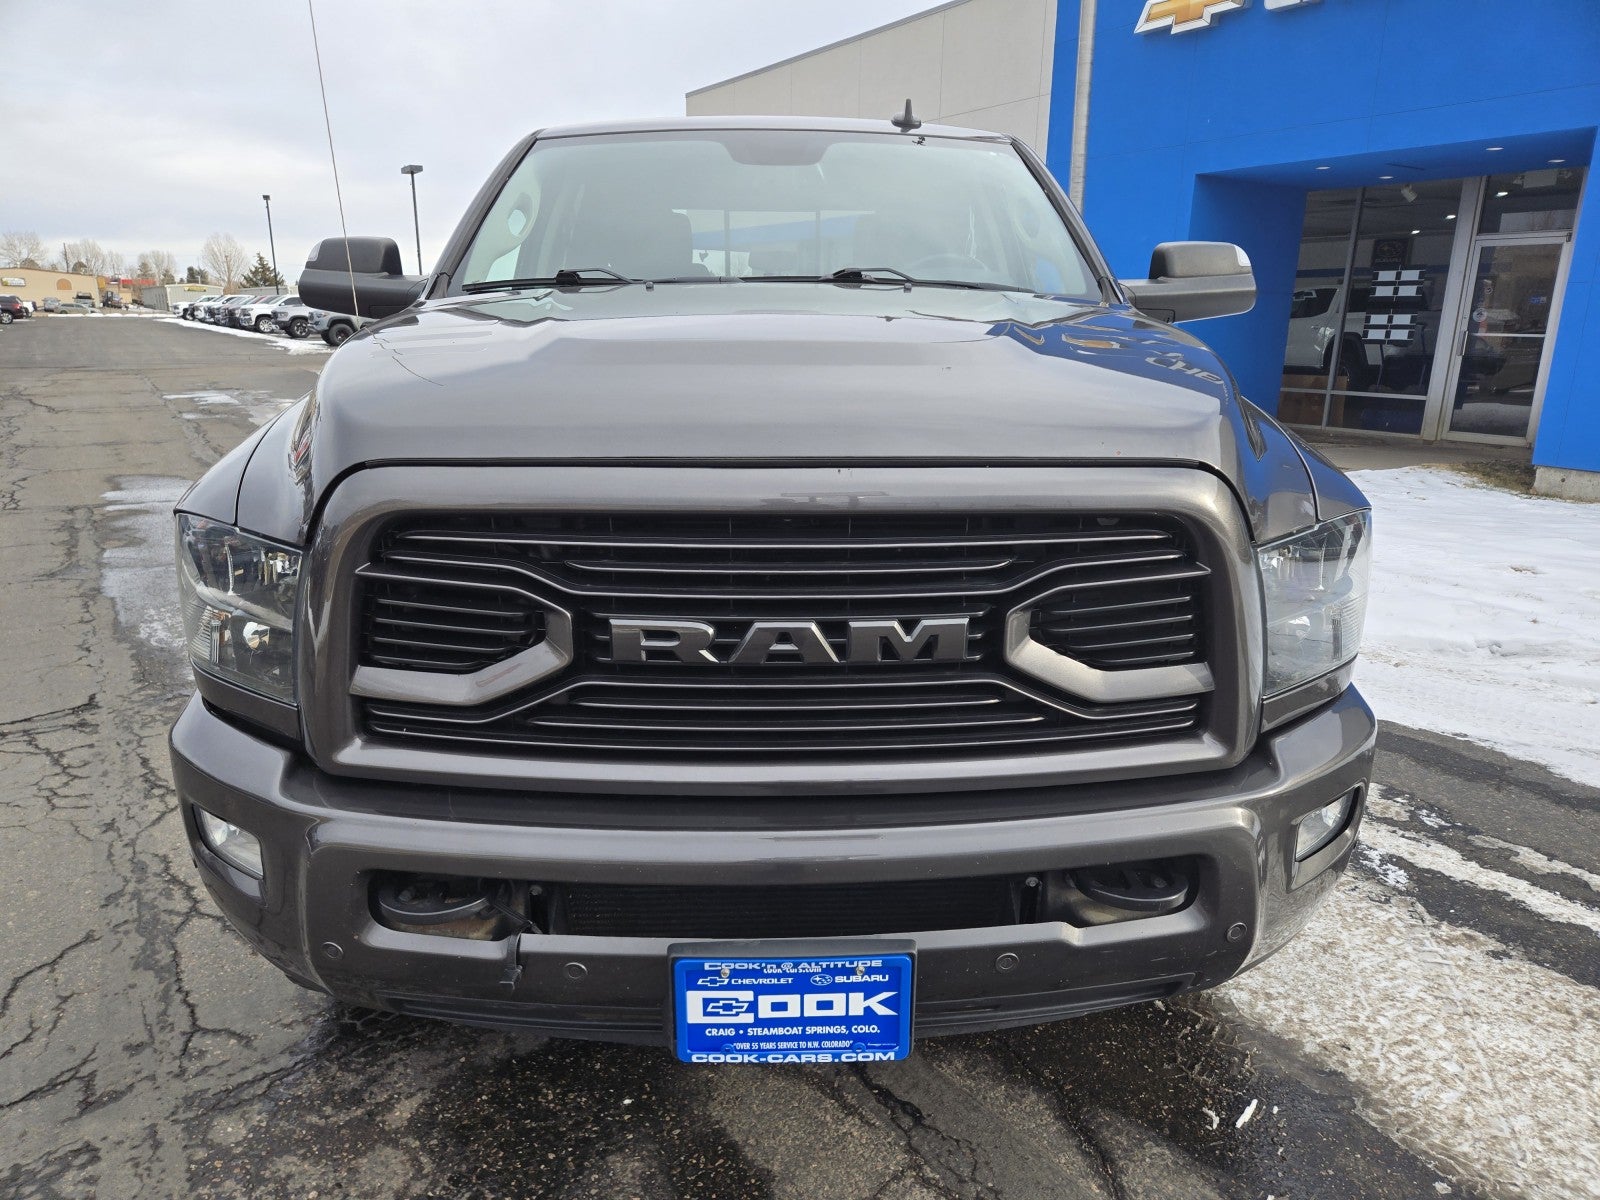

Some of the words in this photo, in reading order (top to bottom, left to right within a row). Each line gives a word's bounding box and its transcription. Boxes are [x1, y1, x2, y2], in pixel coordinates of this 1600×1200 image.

[609, 617, 970, 664] RAM
[798, 960, 883, 969] ALTITUDE
[731, 977, 794, 985] CHEVROLET
[834, 974, 889, 983] SUBARU
[686, 990, 899, 1024] COOK
[705, 1028, 736, 1036] CRAIG
[747, 1026, 804, 1036] STEAMBOAT
[805, 1025, 849, 1035] SPRINGS,
[851, 1025, 880, 1034] COLO.
[777, 1041, 798, 1049] SERVICE
[691, 1051, 895, 1063] COOK-CARS.COM
